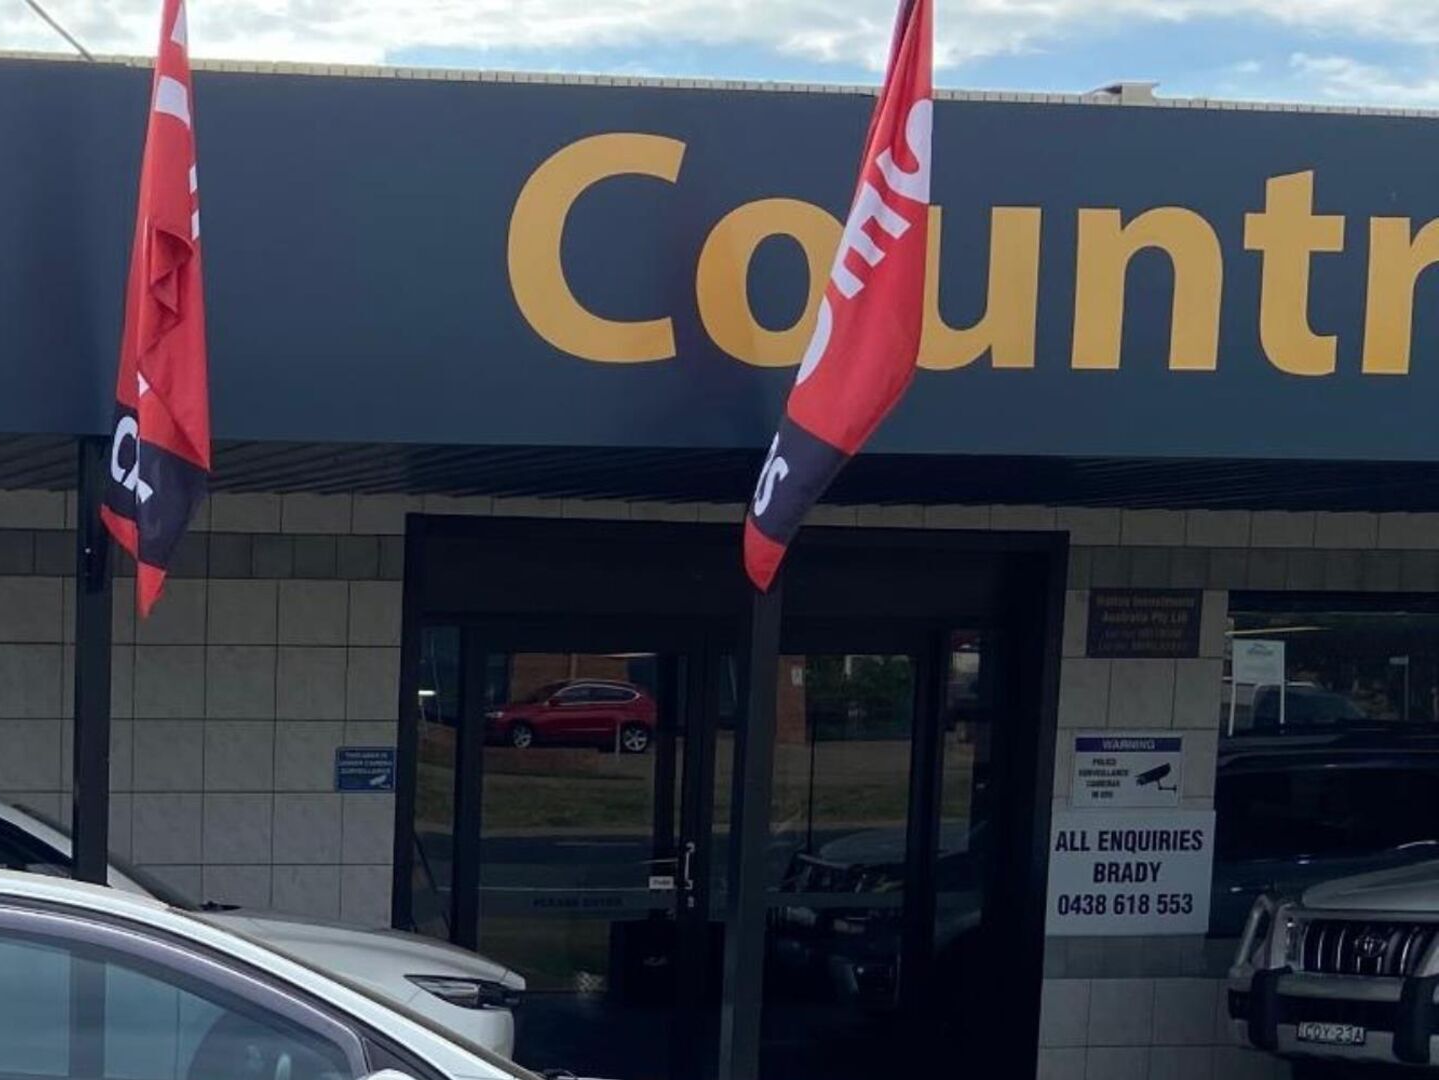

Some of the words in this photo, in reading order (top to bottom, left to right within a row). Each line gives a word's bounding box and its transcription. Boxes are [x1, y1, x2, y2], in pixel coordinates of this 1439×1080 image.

[1055, 830, 1091, 852] ALL
[1098, 829, 1204, 853] ENQUIRIES
[1093, 862, 1163, 884] BRADY
[1057, 894, 1107, 916] 0438
[1113, 894, 1150, 916] 618
[1156, 894, 1194, 915] 553
